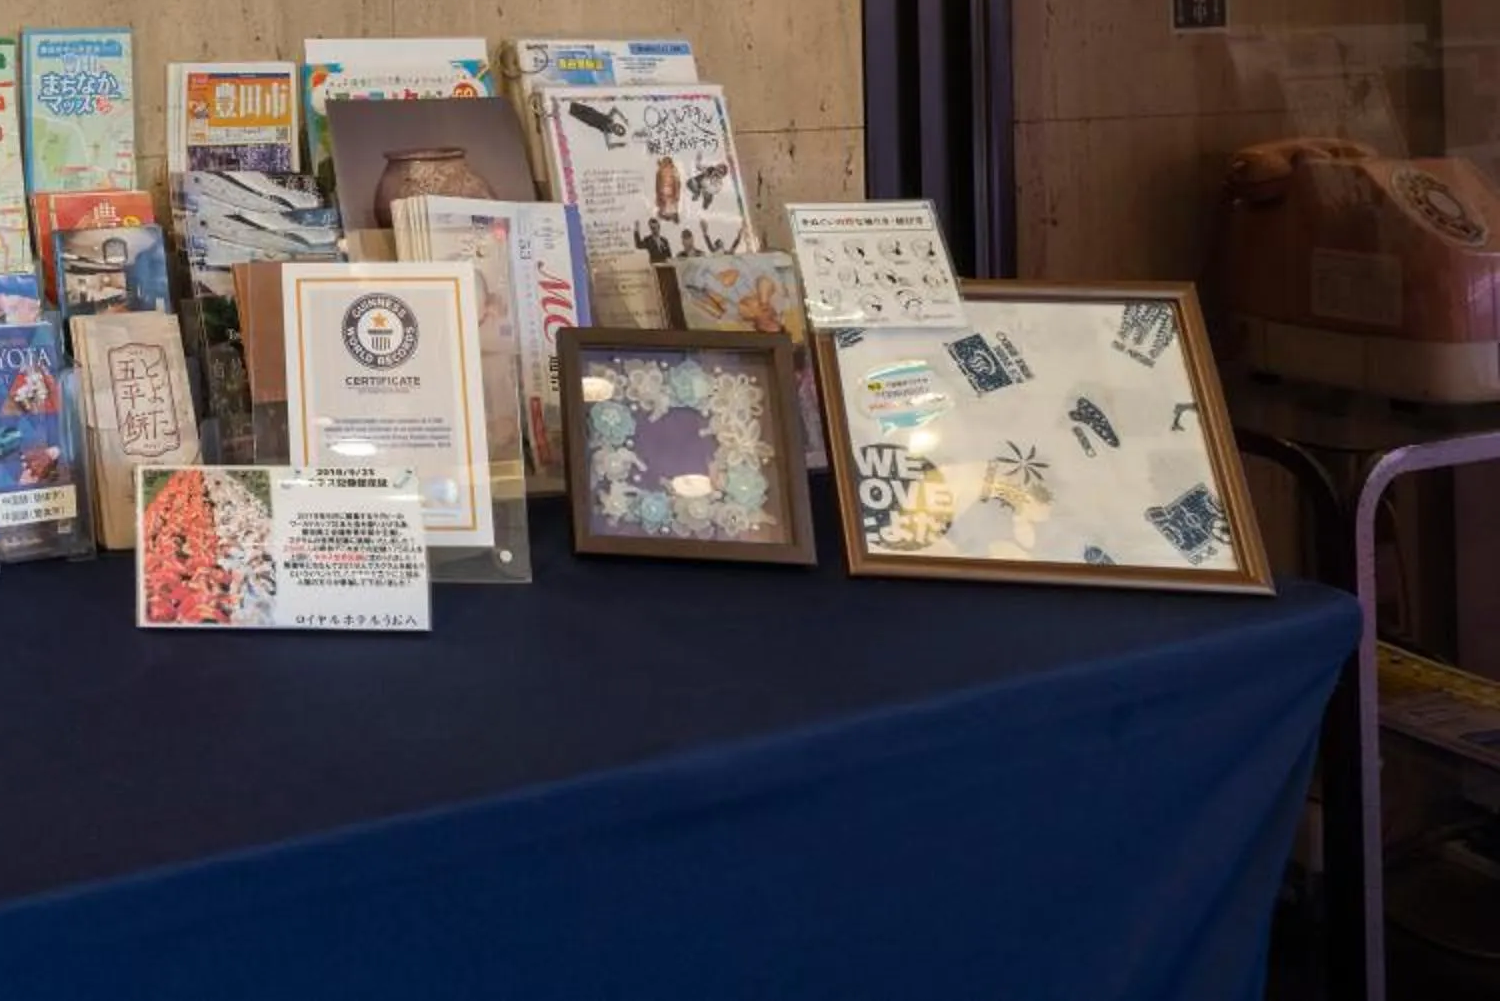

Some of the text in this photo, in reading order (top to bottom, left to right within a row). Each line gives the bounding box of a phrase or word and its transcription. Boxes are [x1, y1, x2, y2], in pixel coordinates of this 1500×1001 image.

[351, 298, 406, 319] GUINNESS
[346, 326, 415, 365] WORLD RECORDS
[345, 376, 421, 386] CERTIFICATE
[858, 447, 925, 479] WE
[858, 479, 954, 511] OVE
